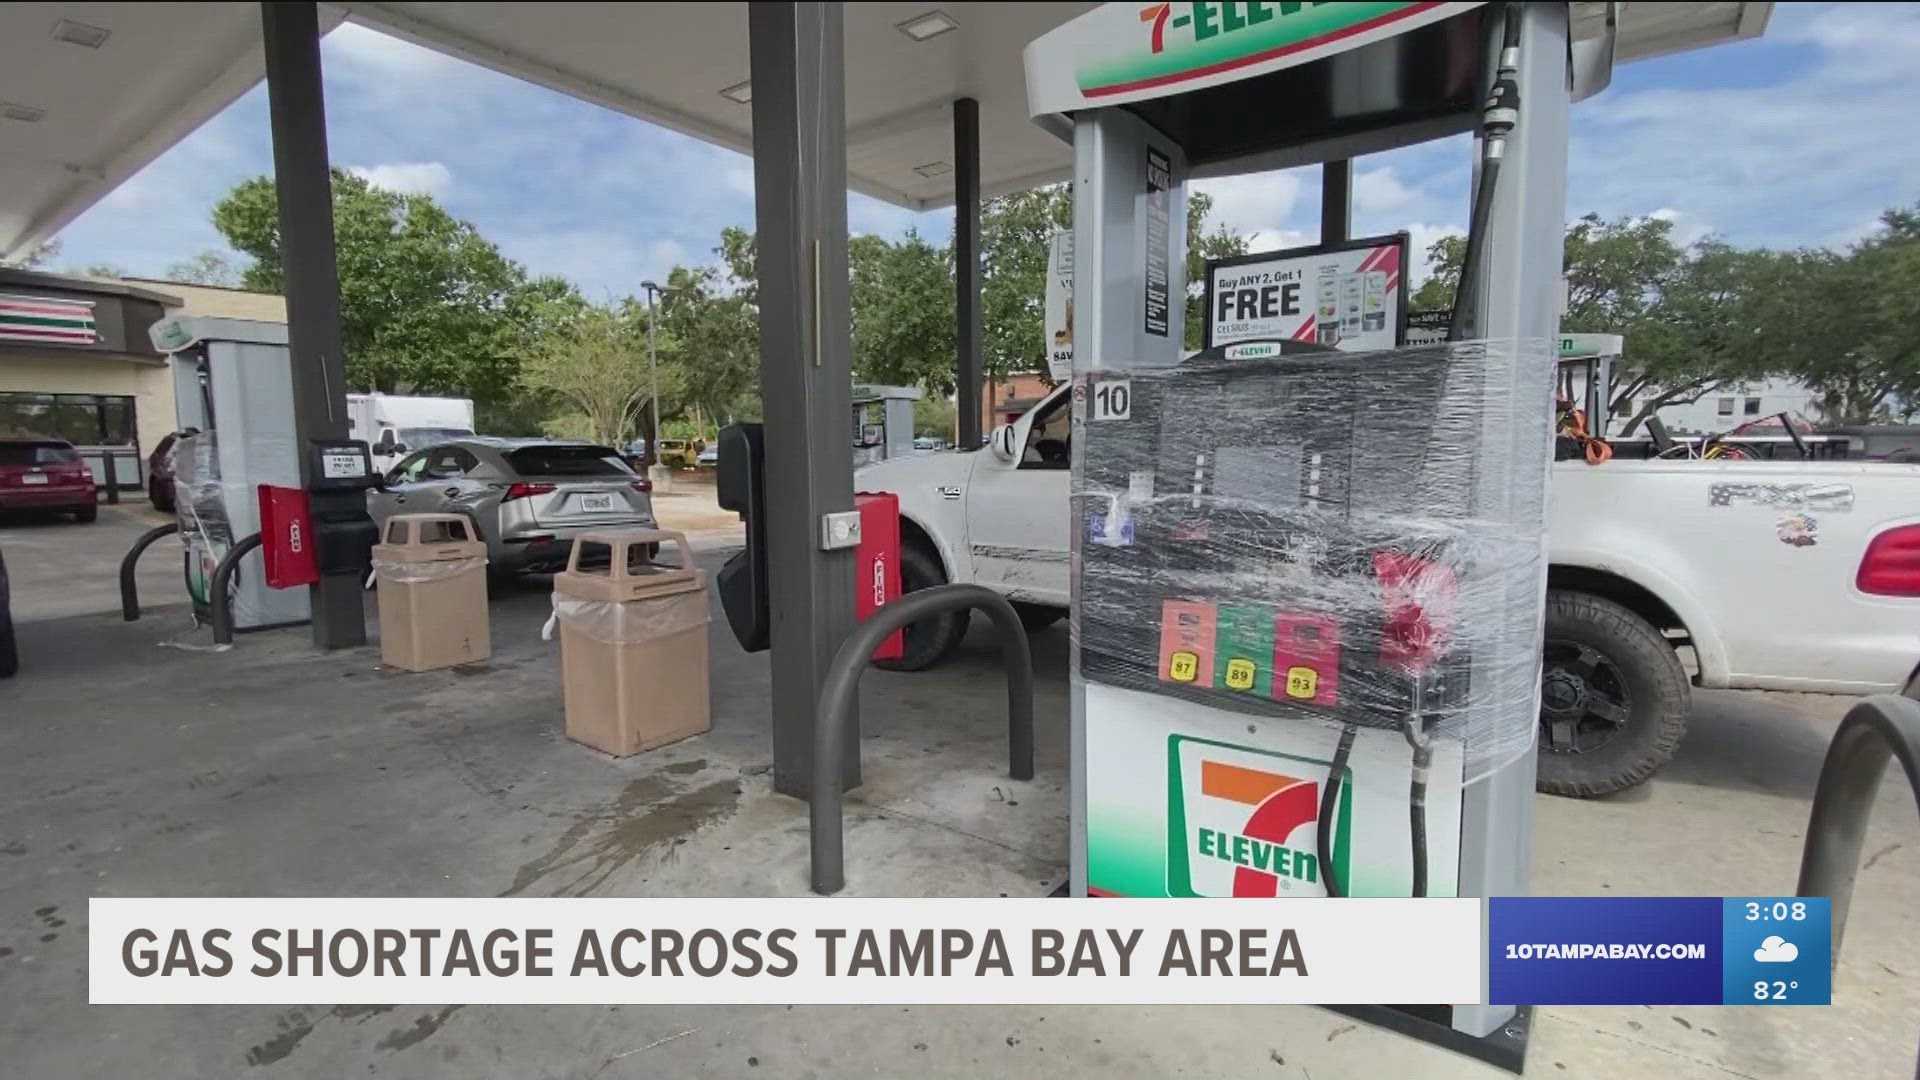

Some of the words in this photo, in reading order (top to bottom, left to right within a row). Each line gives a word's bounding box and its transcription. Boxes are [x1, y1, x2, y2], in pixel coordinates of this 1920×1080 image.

[1239, 276, 1261, 286] ANY
[1218, 283, 1301, 322] FREE
[1097, 384, 1129, 416] 10
[1175, 662, 1190, 674] 87
[1231, 669, 1249, 682] 89
[1291, 677, 1311, 691] 93
[1202, 760, 1319, 898] 7
